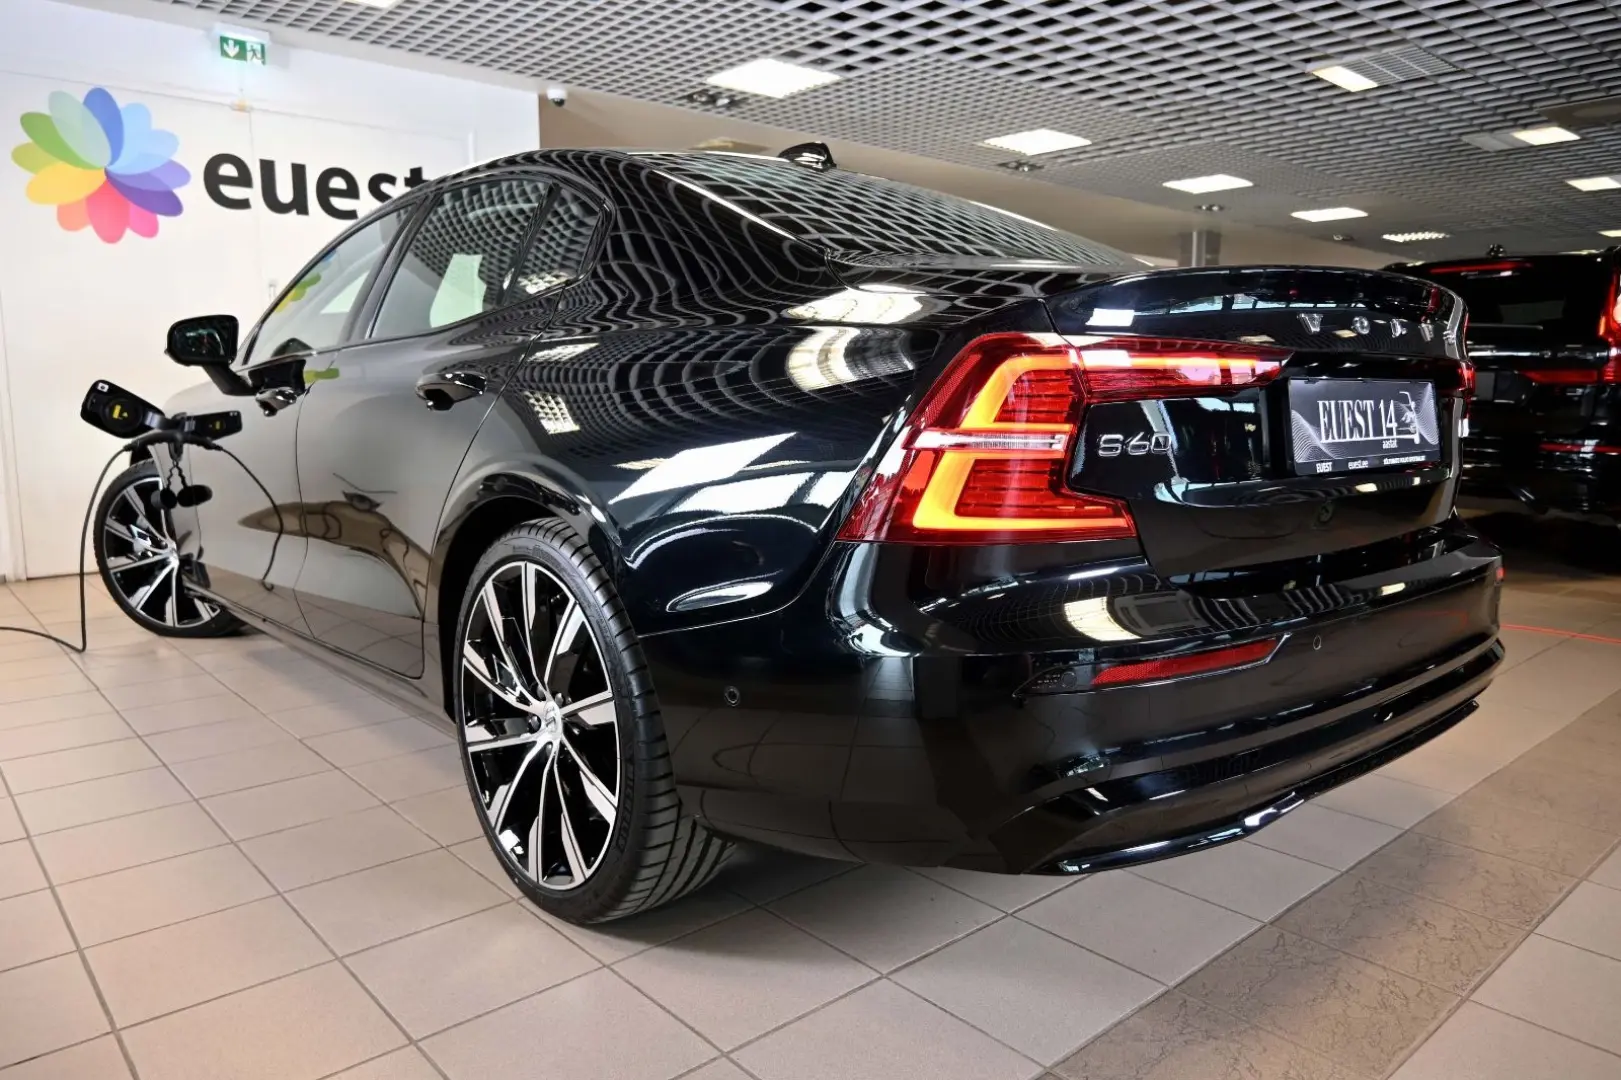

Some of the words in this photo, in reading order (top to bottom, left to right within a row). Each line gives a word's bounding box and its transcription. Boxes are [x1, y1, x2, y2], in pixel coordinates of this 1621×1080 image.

[1317, 399, 1375, 443] EUEST
[1379, 399, 1398, 438] 14
[1098, 432, 1172, 457] S60
[1316, 462, 1333, 473] EUEST
